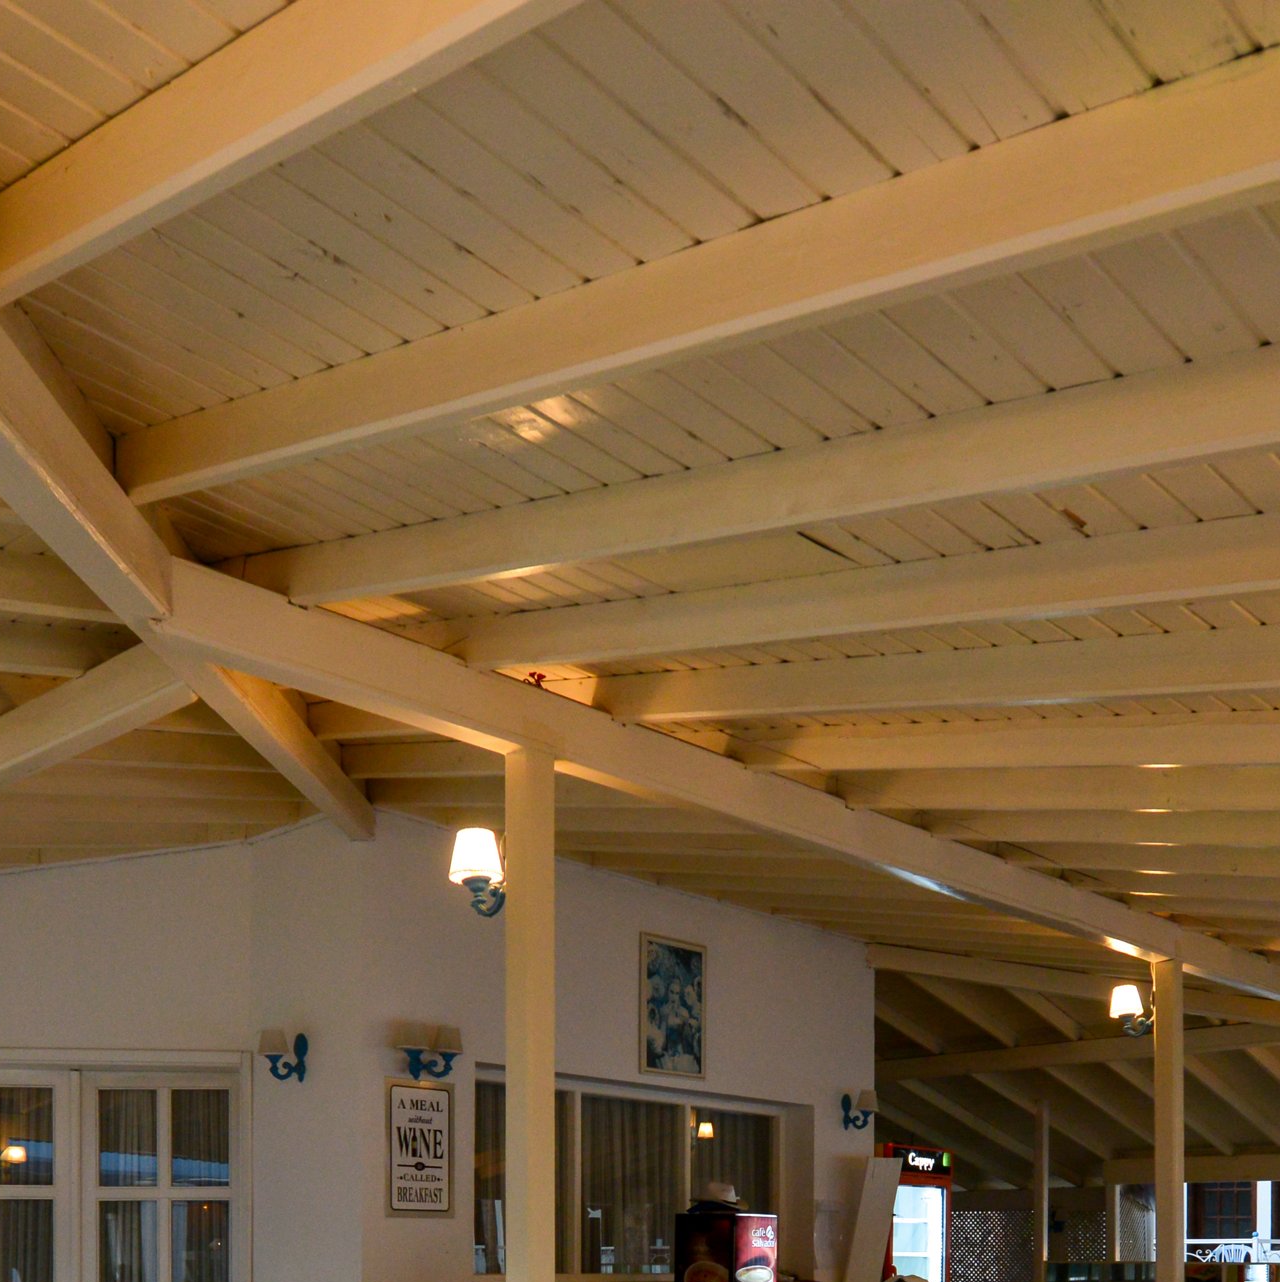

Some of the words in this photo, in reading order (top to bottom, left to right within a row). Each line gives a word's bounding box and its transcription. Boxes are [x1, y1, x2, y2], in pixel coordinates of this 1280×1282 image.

[397, 1098, 406, 1109] A
[410, 1099, 443, 1113] MEAL
[408, 1114, 433, 1125] without
[397, 1126, 444, 1160] WINE
[908, 1152, 935, 1171] Cappy
[403, 1173, 437, 1183] CALLED
[397, 1186, 443, 1204] BREAKFAST
